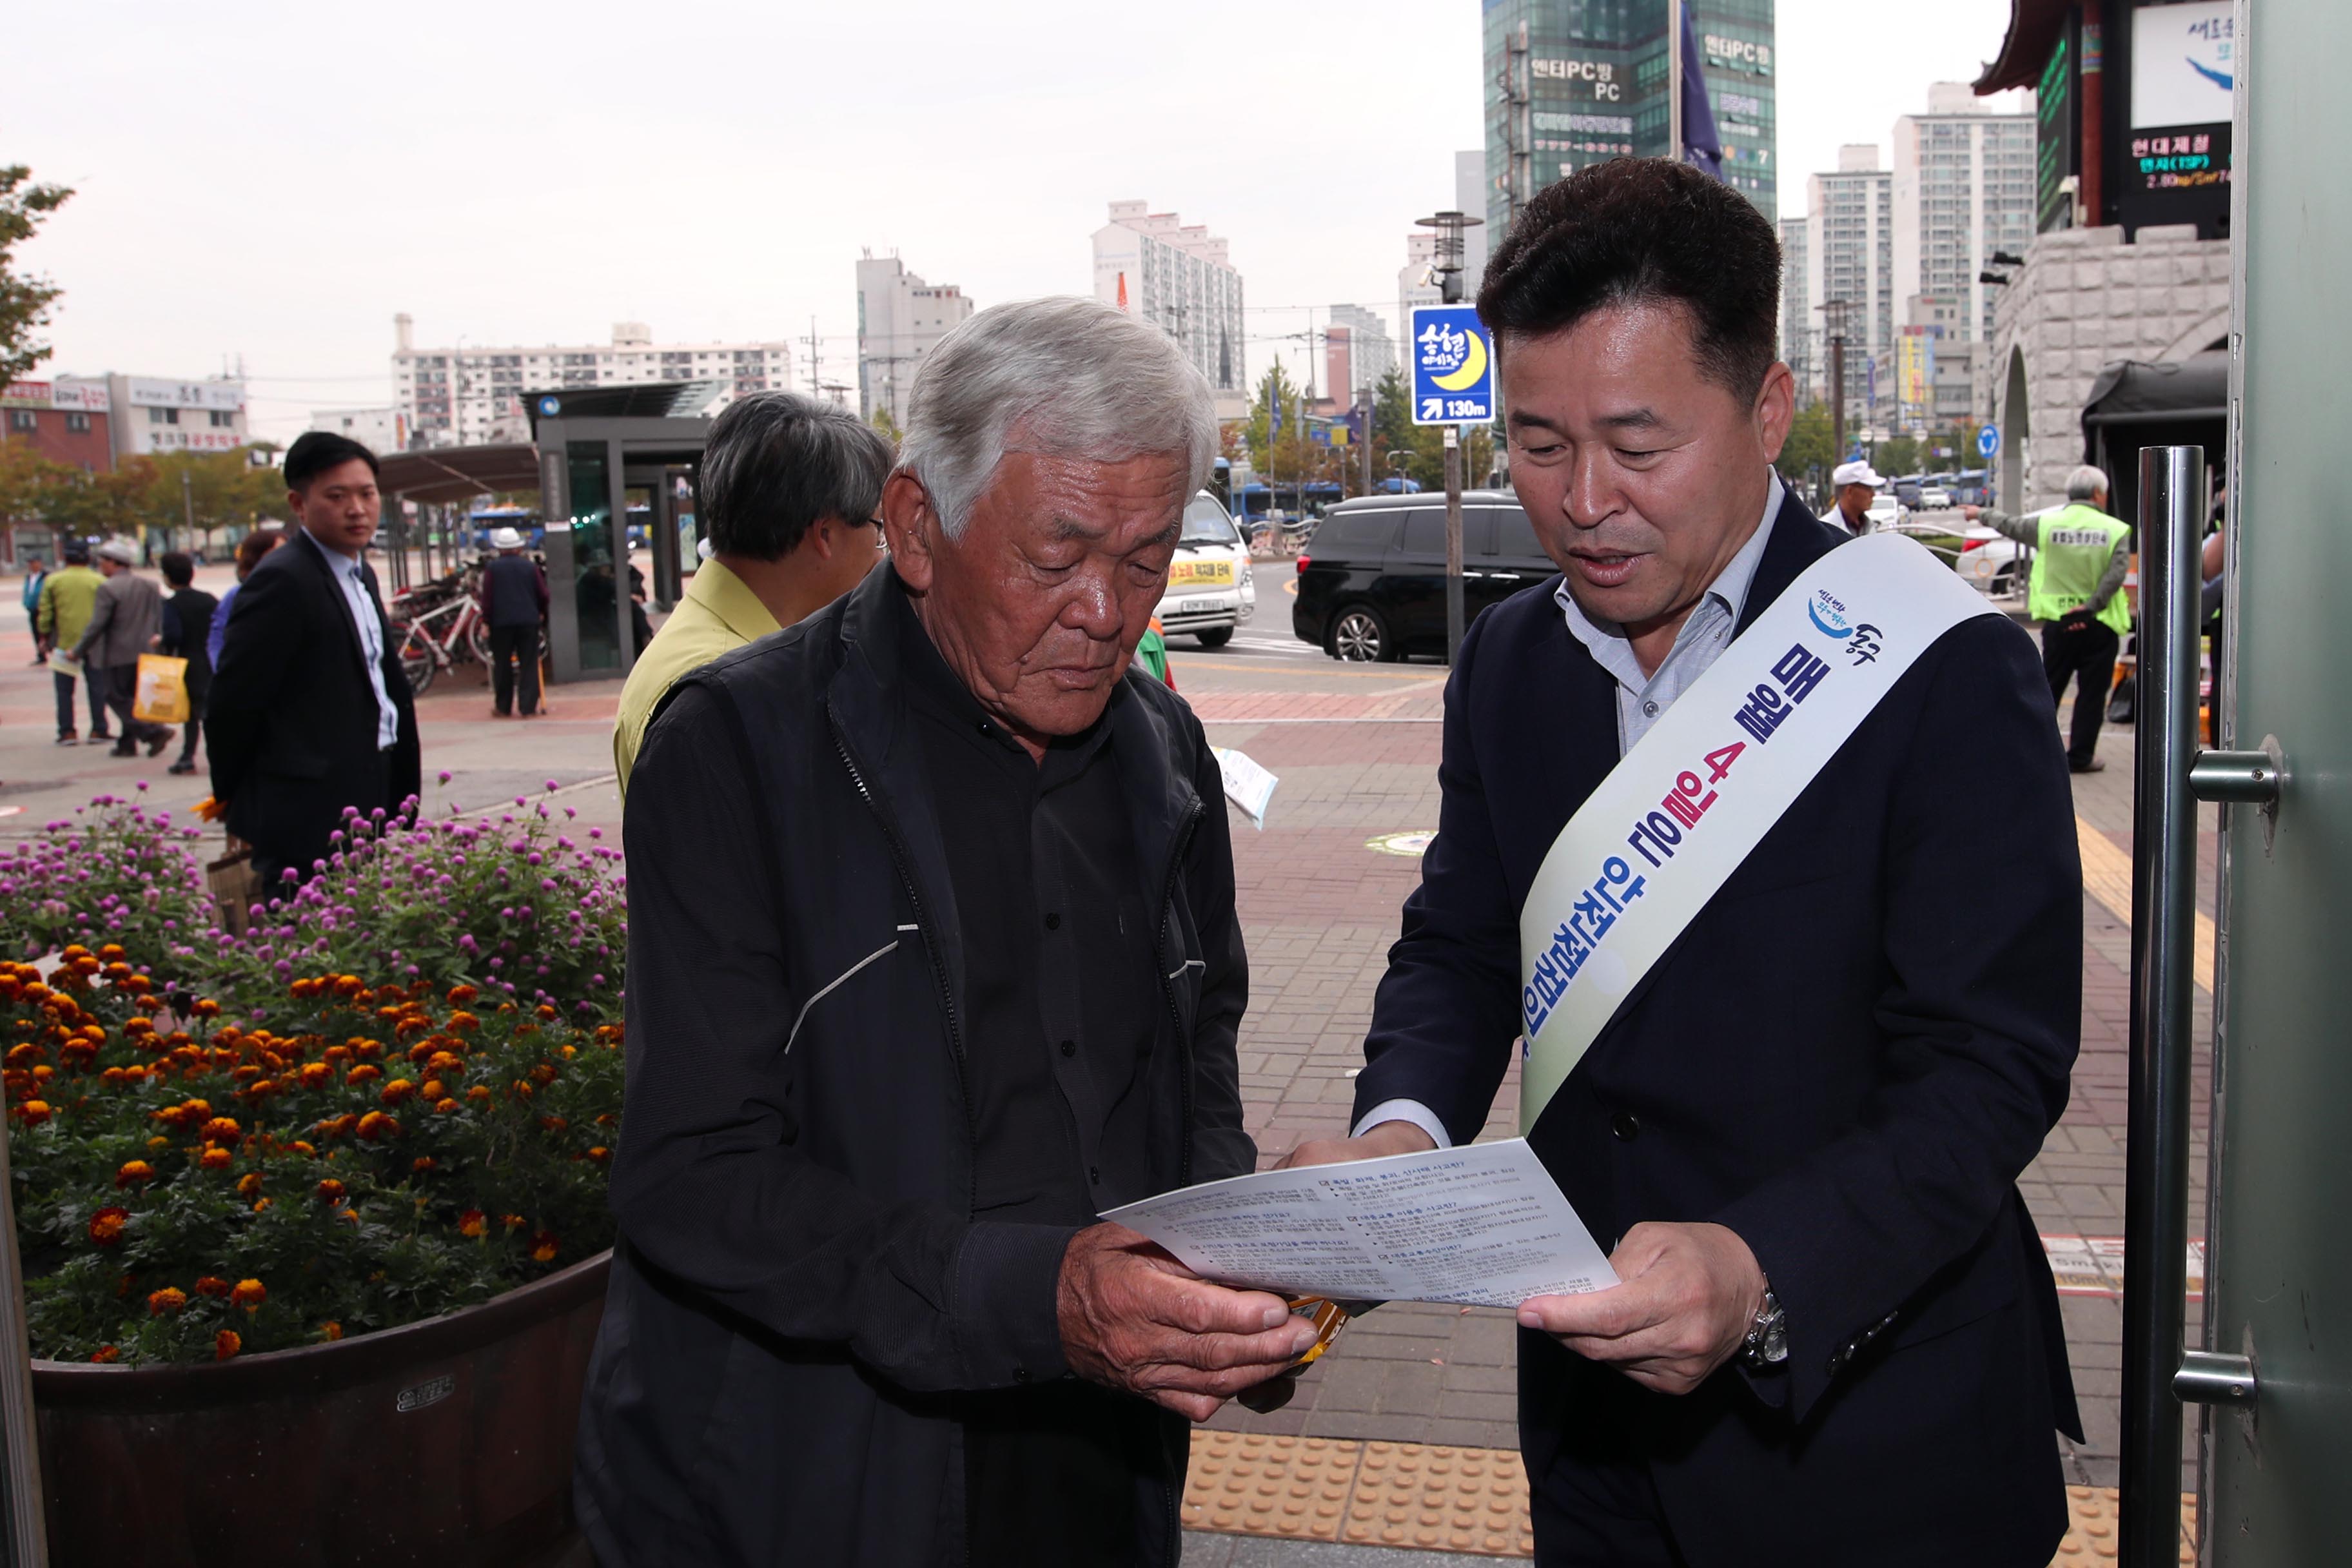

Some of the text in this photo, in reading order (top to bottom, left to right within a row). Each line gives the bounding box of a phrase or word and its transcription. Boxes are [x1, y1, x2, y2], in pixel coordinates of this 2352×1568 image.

[1595, 82, 1620, 101] PC
[2132, 134, 2210, 157] 현대제철
[1418, 323, 1465, 359] 송현
[1422, 352, 1460, 367] 야시장
[1447, 400, 1485, 417] 130m
[1177, 563, 1193, 578] 노점
[1818, 589, 1846, 613] 새로운 변화
[1845, 623, 1883, 666] 동구
[1523, 643, 1831, 1037] 매월 4일은 안전점검의
[1402, 1166, 1431, 1175] 산사태
[1433, 1161, 1464, 1171] 사고란?
[1426, 1202, 1457, 1211] 사고란?
[1391, 1244, 1462, 1258] 대중교통수단이란?
